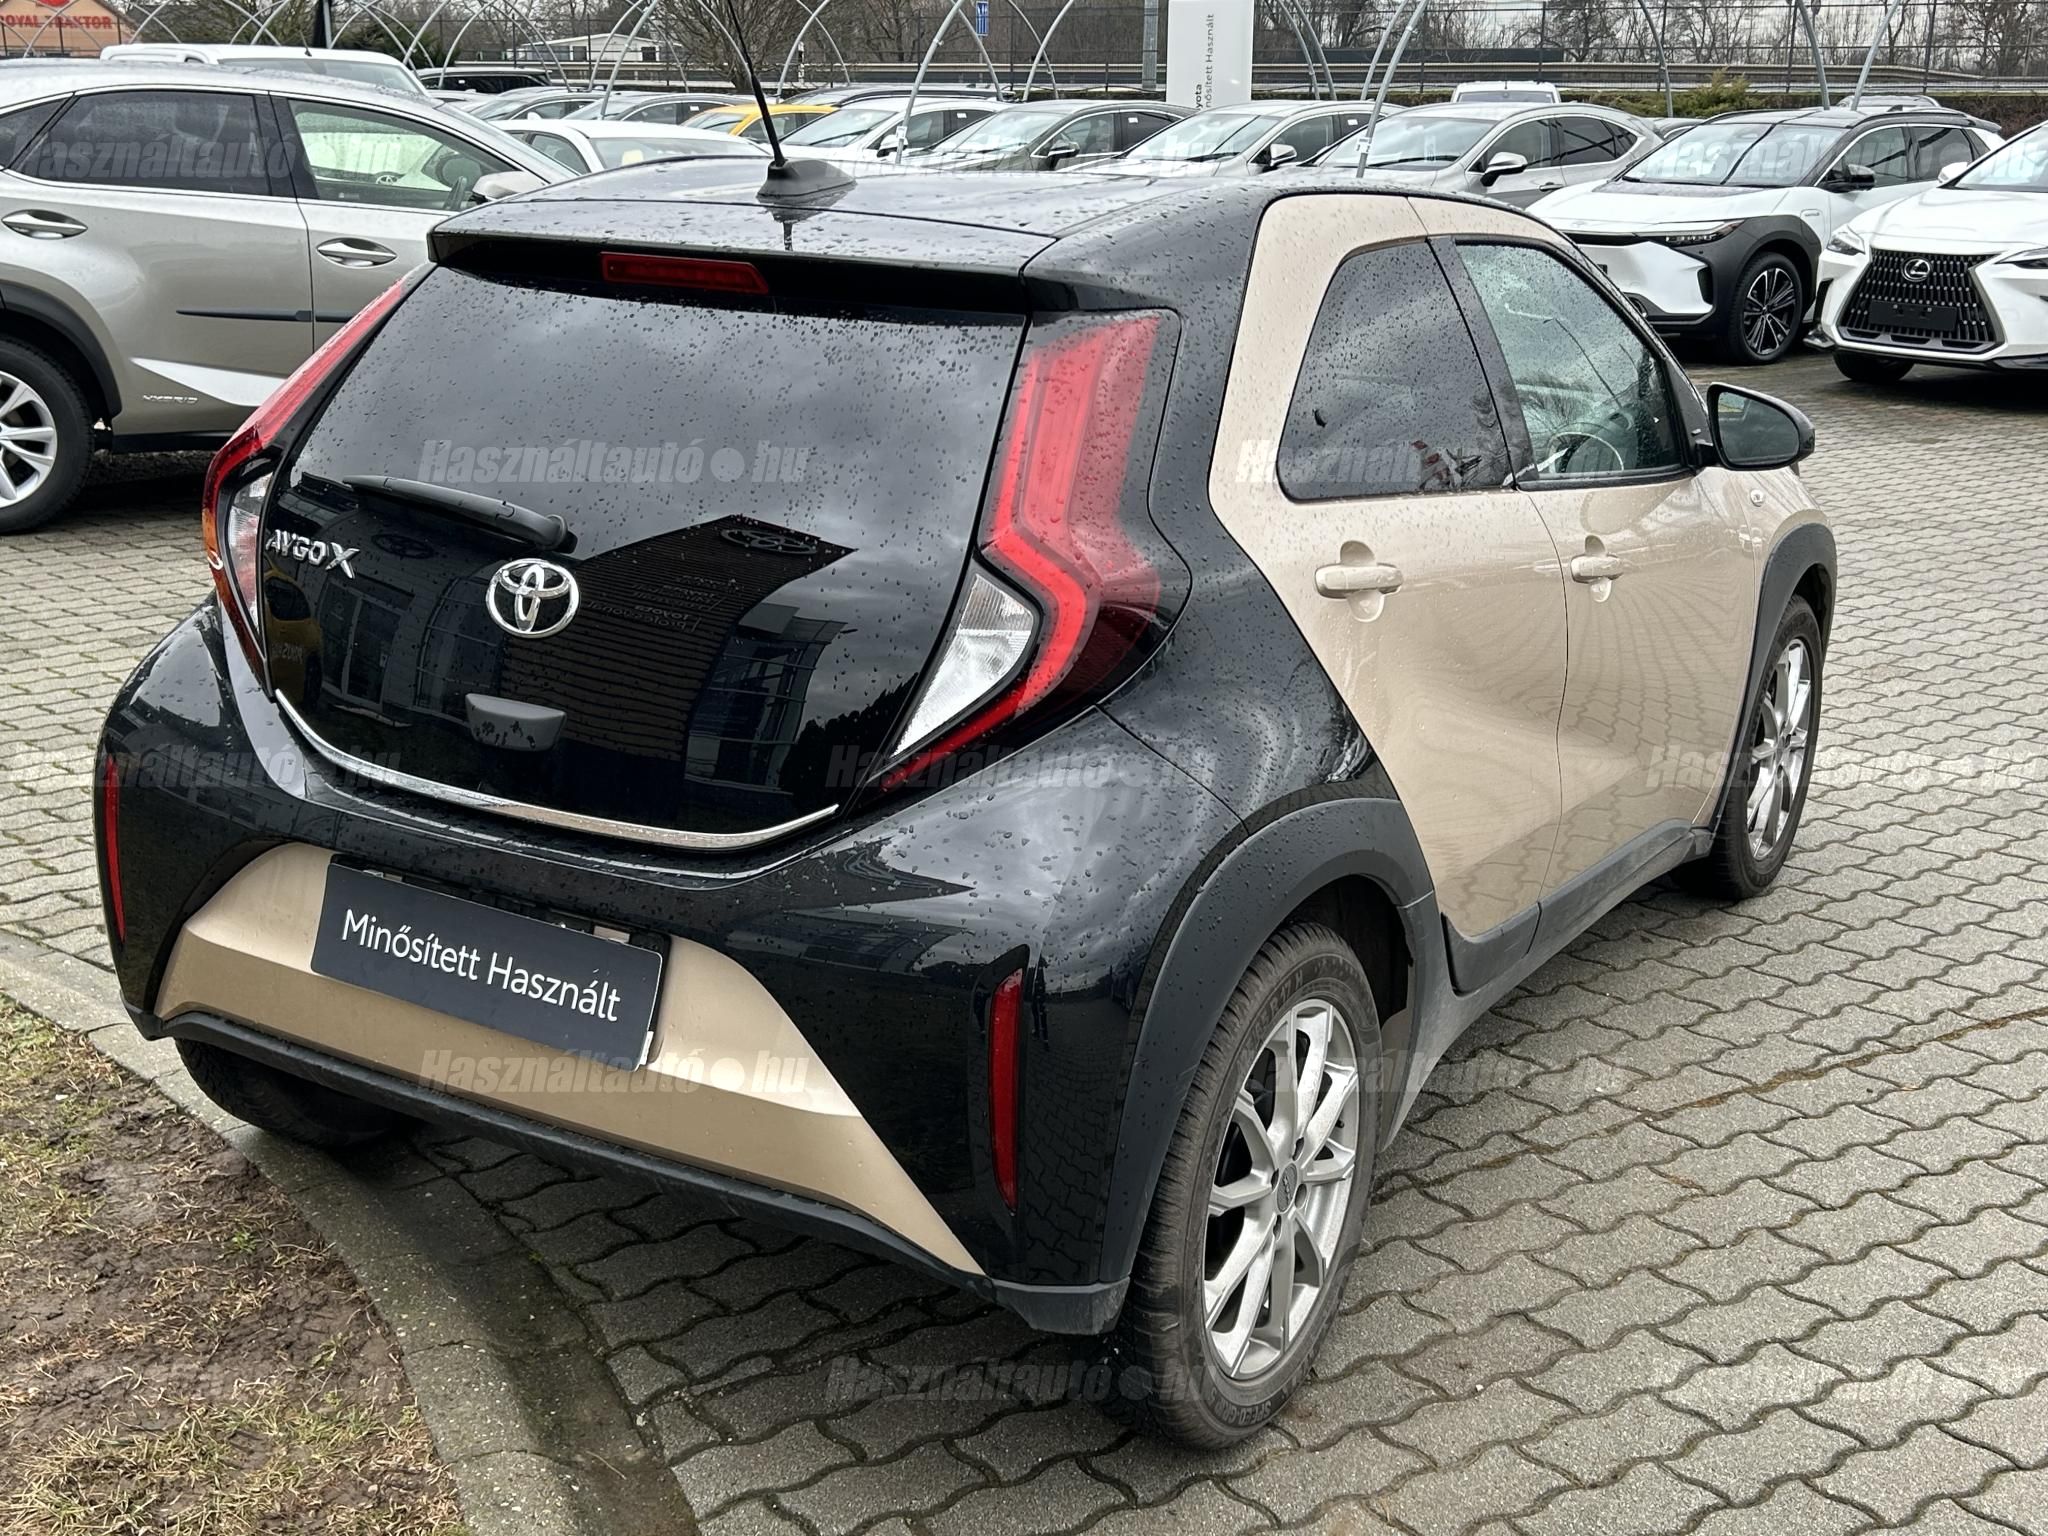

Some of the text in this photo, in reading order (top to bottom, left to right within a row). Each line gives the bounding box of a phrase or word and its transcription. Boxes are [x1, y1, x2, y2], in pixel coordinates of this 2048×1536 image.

[1194, 84, 1203, 110] yota
[1205, 65, 1213, 108] nősített
[265, 529, 327, 566] AYGO
[341, 908, 621, 1022] Minősített Használt
